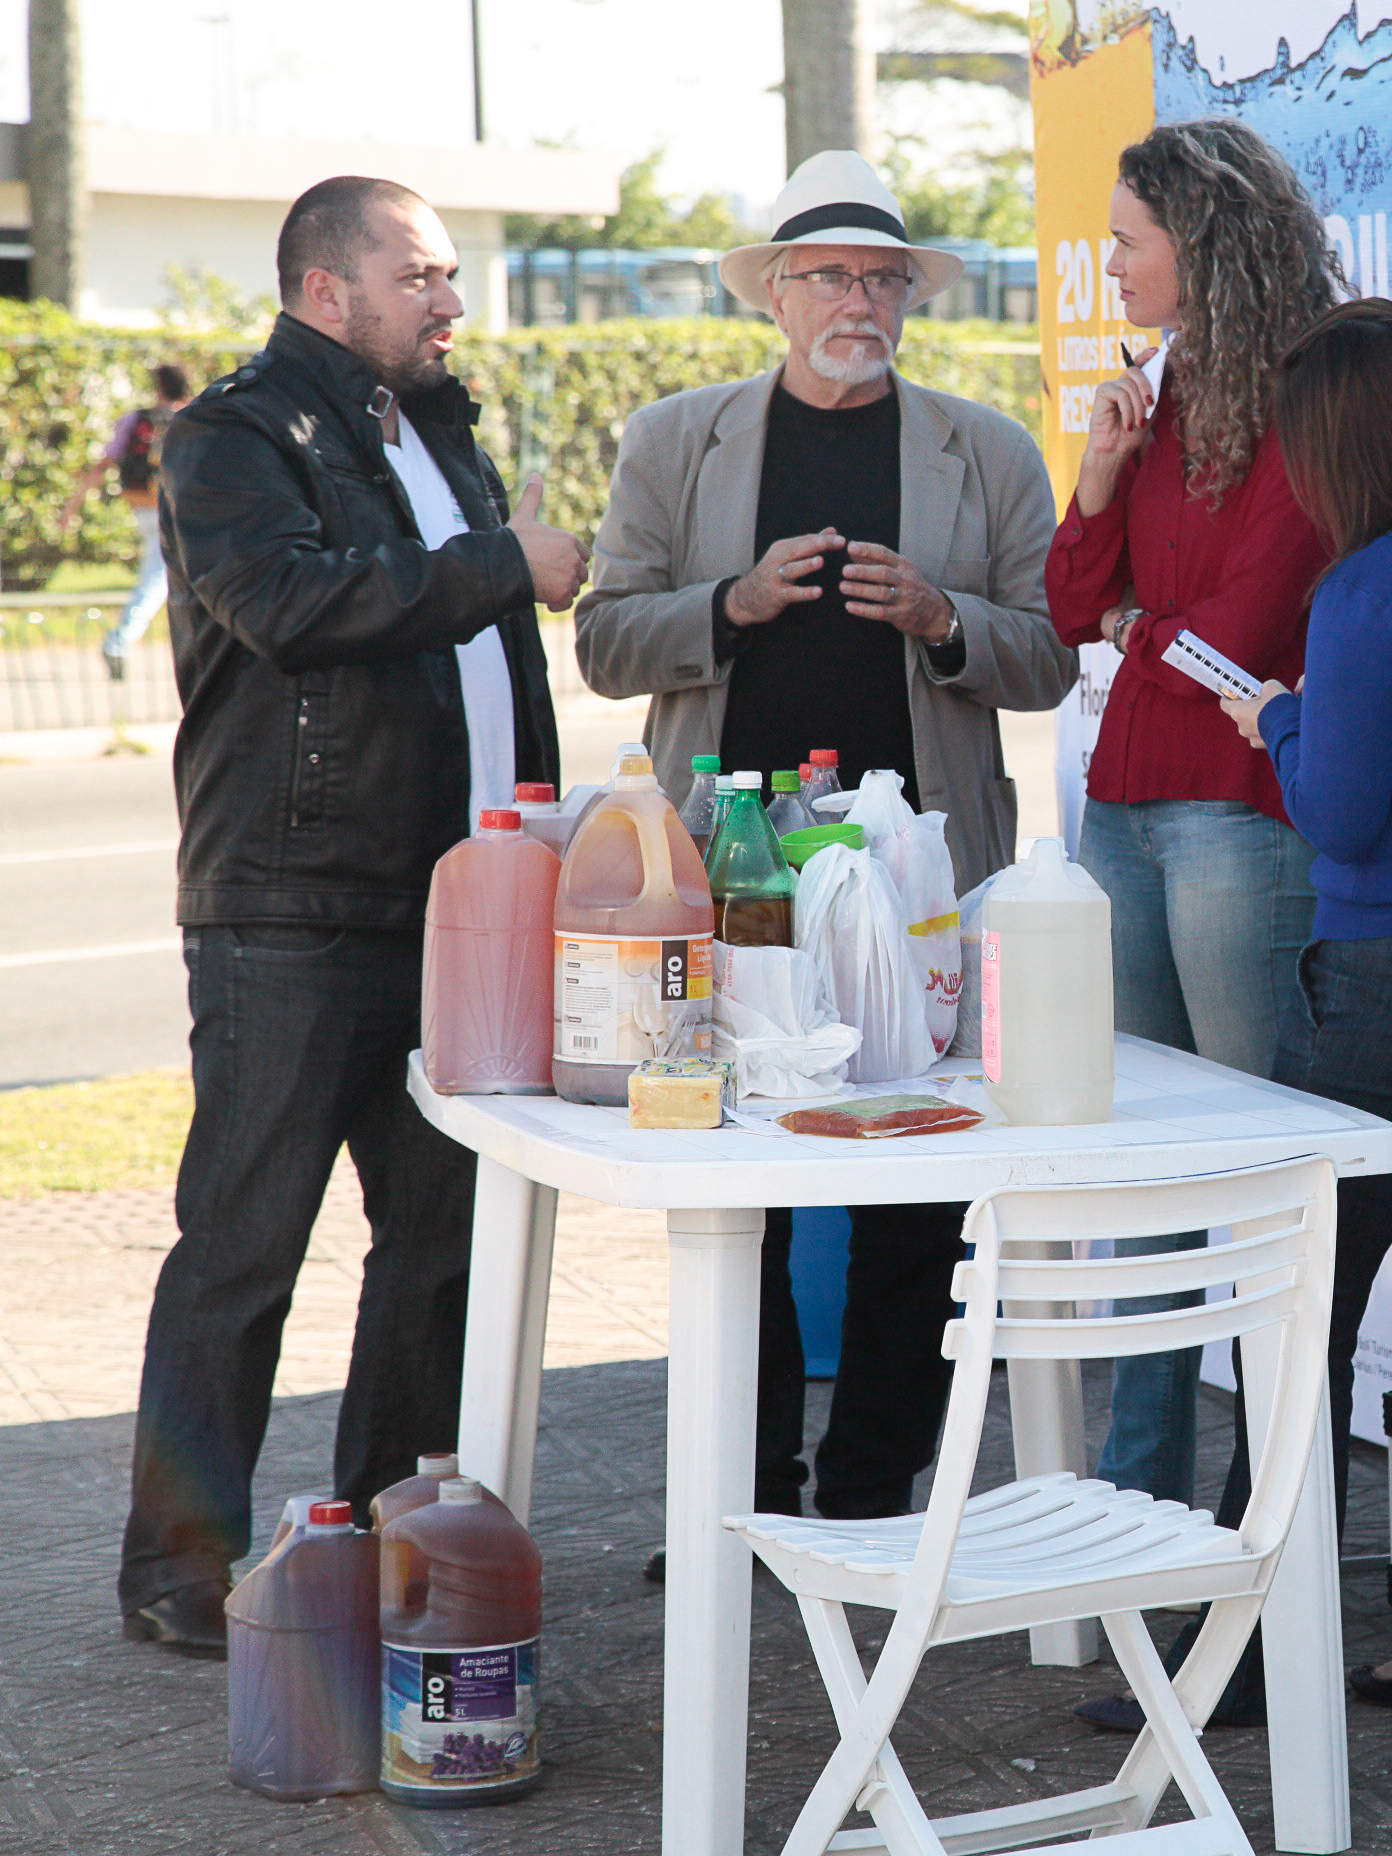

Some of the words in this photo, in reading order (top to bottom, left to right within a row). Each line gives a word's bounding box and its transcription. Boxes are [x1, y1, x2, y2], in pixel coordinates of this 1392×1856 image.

[1056, 239, 1094, 324] 20
[667, 955, 683, 998] aro
[460, 1655, 510, 1667] Amaciante
[461, 1668, 473, 1678] de
[475, 1665, 509, 1679] Roupas
[427, 1677, 445, 1719] aro
